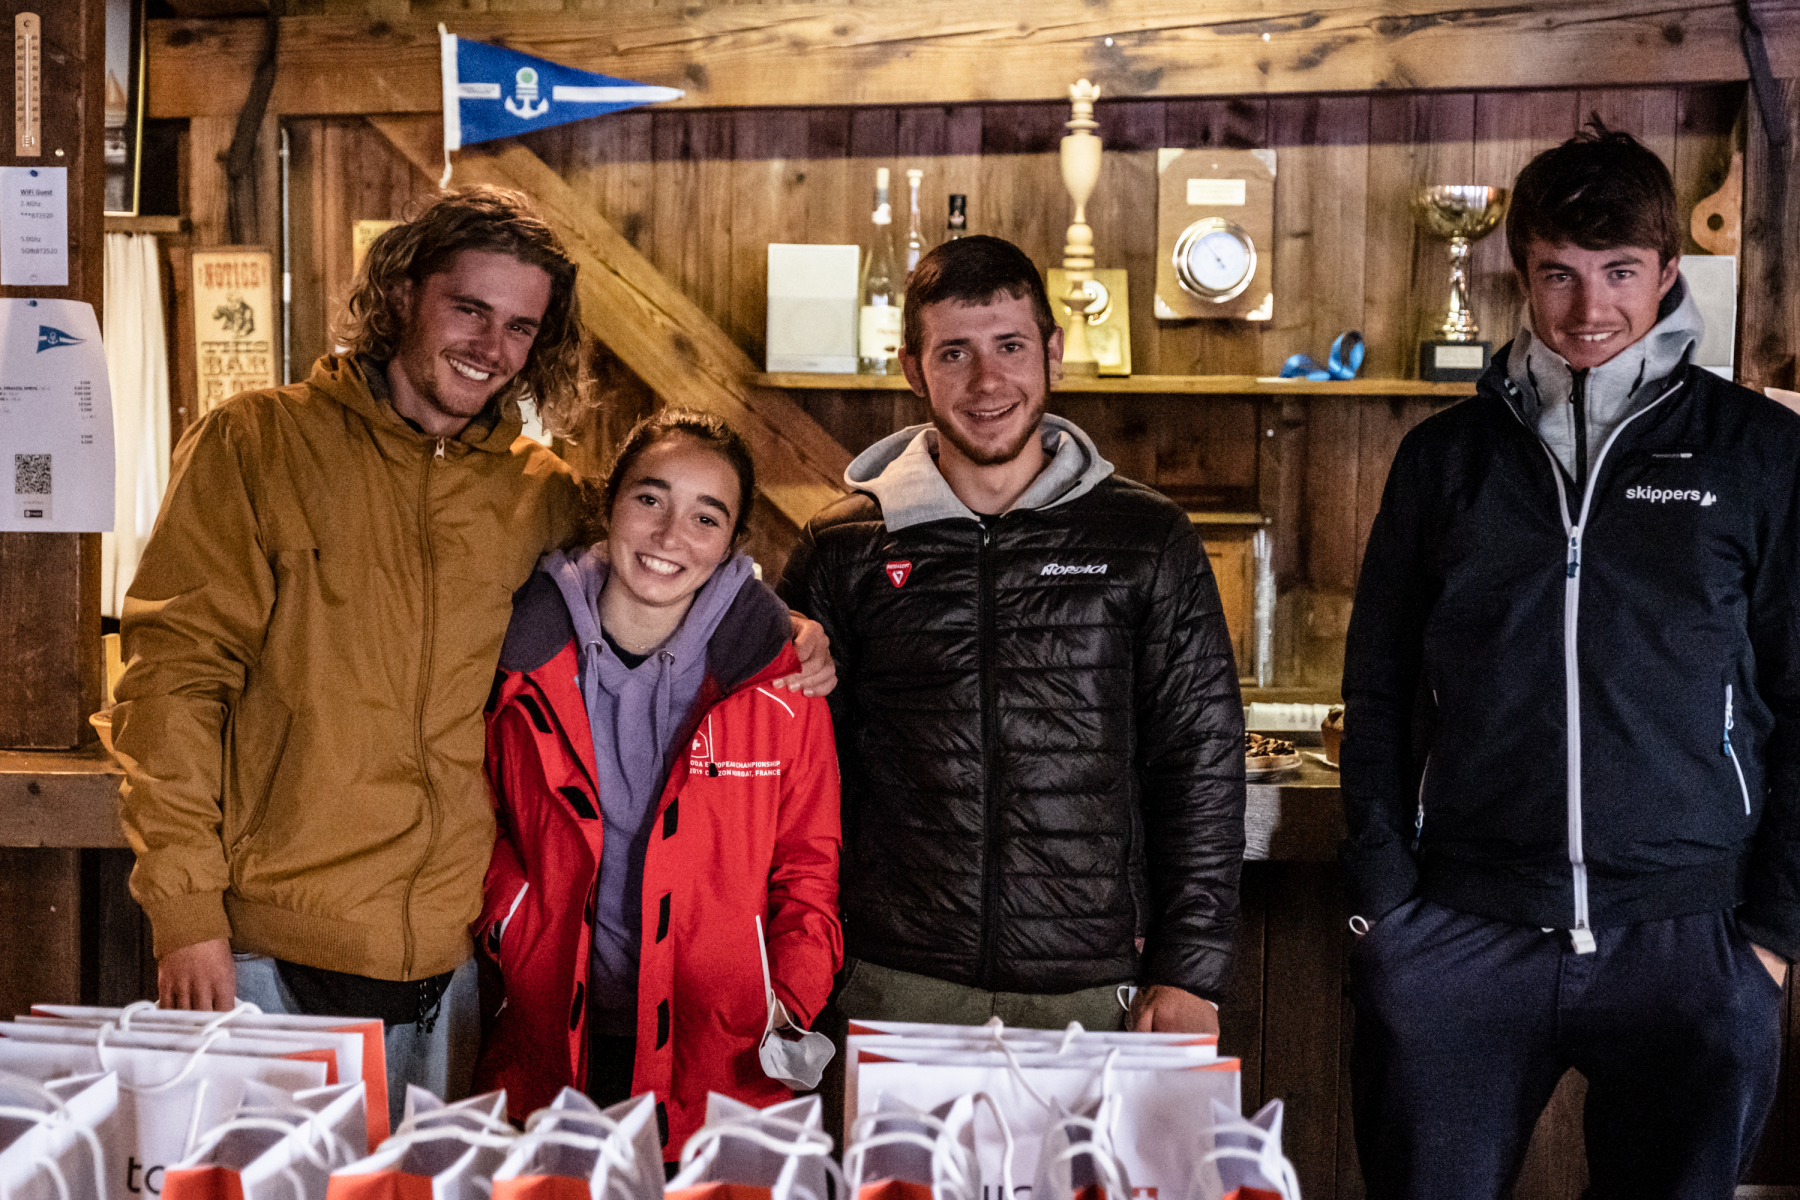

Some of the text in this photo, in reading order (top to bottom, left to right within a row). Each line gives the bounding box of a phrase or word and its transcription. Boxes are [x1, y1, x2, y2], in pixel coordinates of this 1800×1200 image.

[204, 261, 260, 289] NOTICE
[201, 341, 268, 353] THIS
[202, 355, 269, 376] BAR
[1625, 485, 1701, 504] skippers
[1040, 563, 1108, 576] NORDICA
[736, 761, 781, 769] CHAMPIONSHIP
[705, 769, 732, 777] CZON
[755, 769, 781, 777] FRANCE
